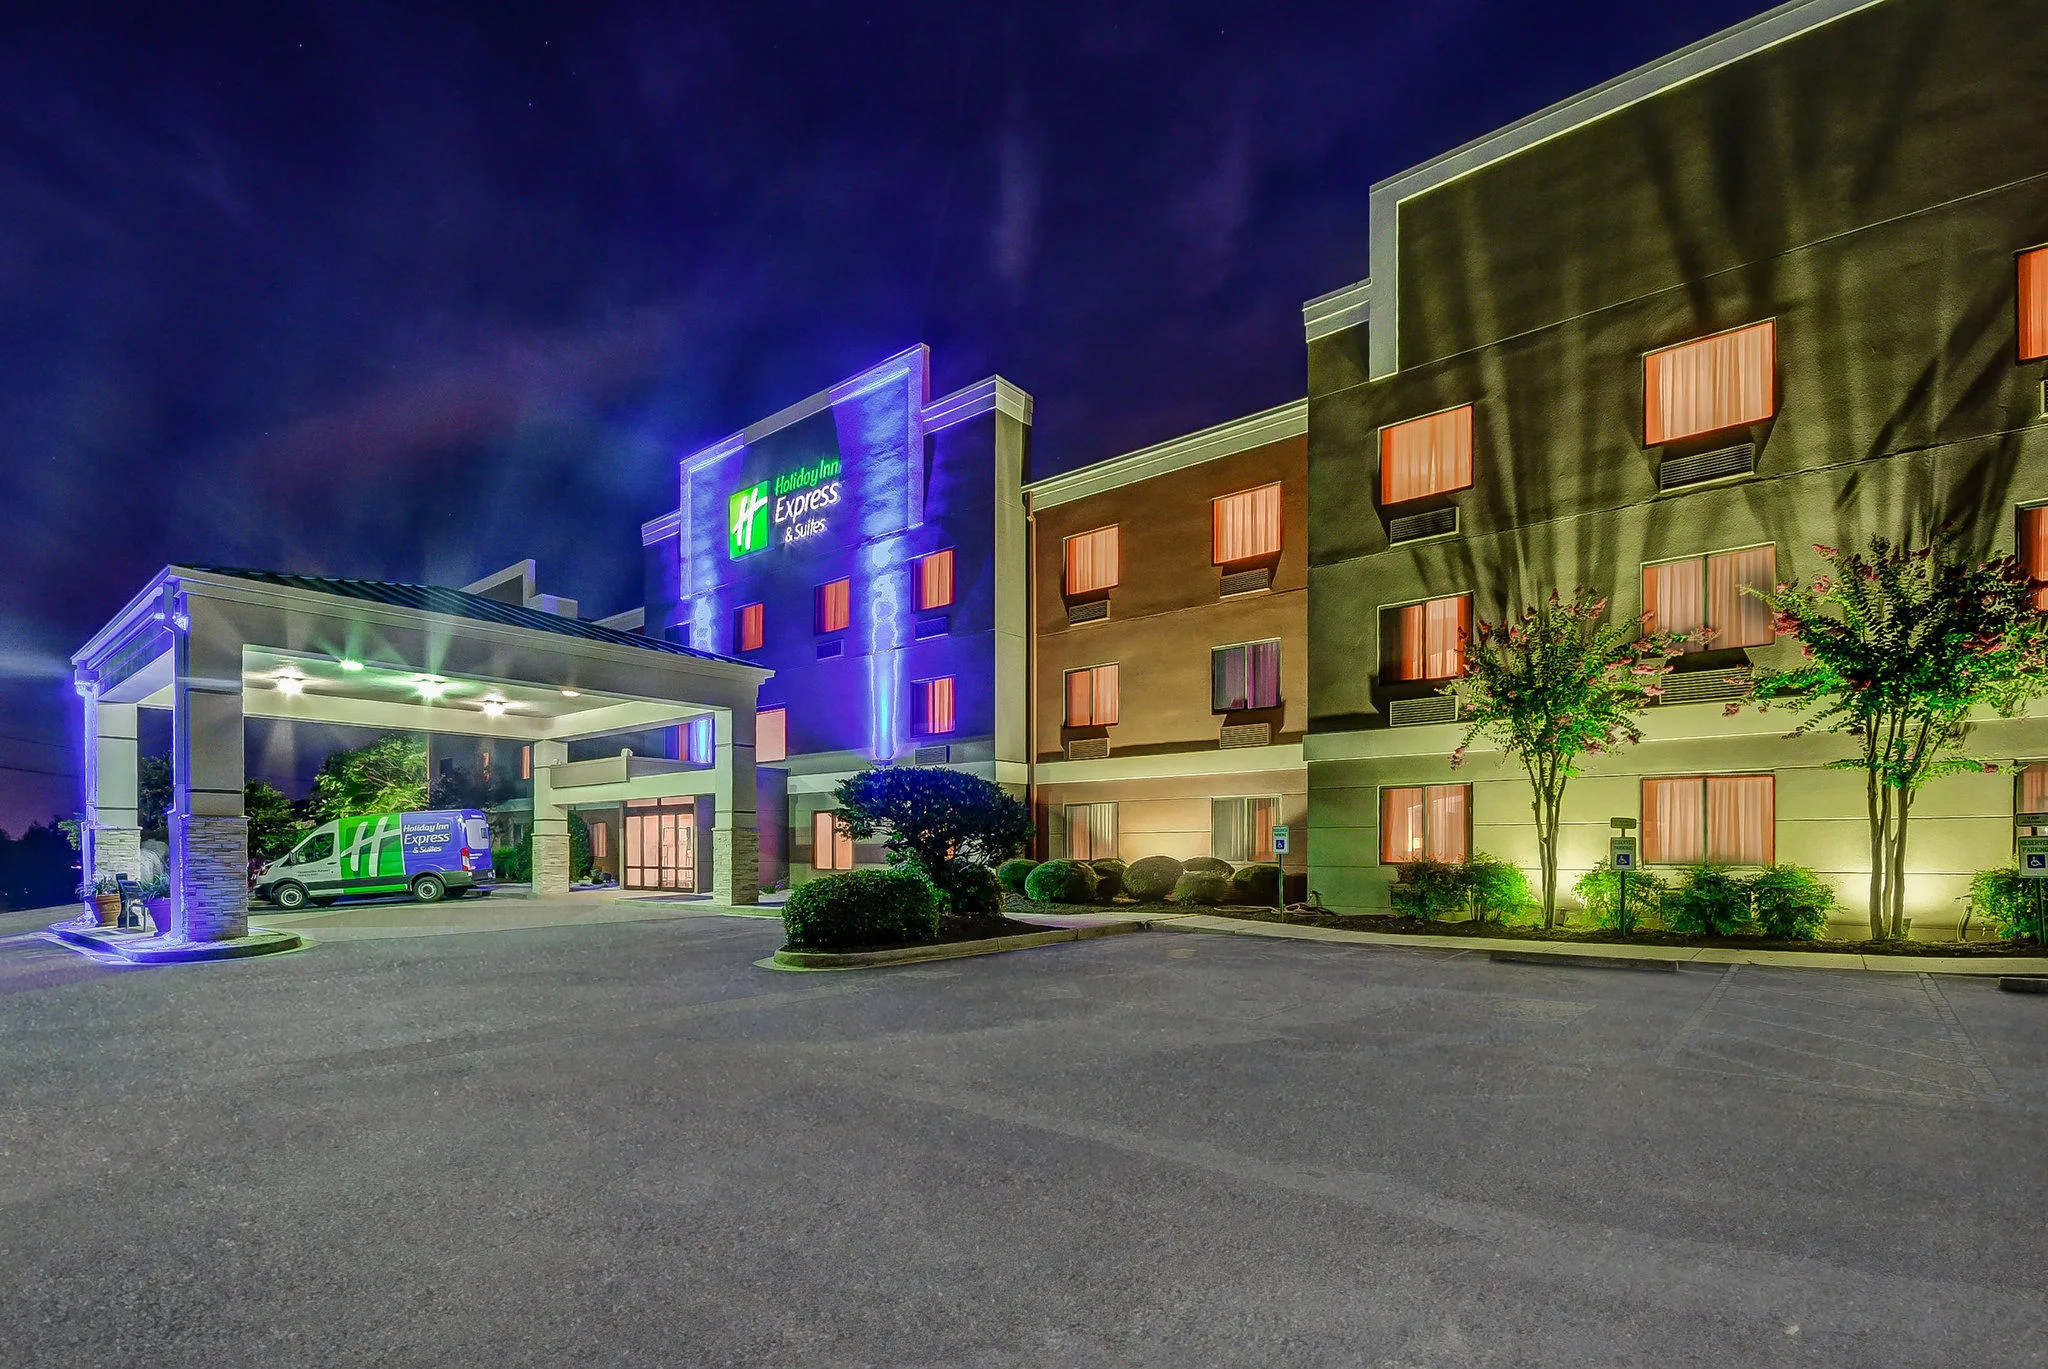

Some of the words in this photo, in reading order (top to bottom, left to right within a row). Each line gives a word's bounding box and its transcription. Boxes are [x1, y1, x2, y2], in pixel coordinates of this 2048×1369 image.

[775, 467, 819, 496] Holiday
[819, 459, 839, 479] Inn
[775, 482, 840, 523] Express
[785, 526, 793, 542] &
[794, 518, 826, 539] Suites
[403, 824, 436, 832] Holiday
[436, 822, 450, 831] Inn
[404, 833, 450, 846] Express
[412, 846, 419, 854] &
